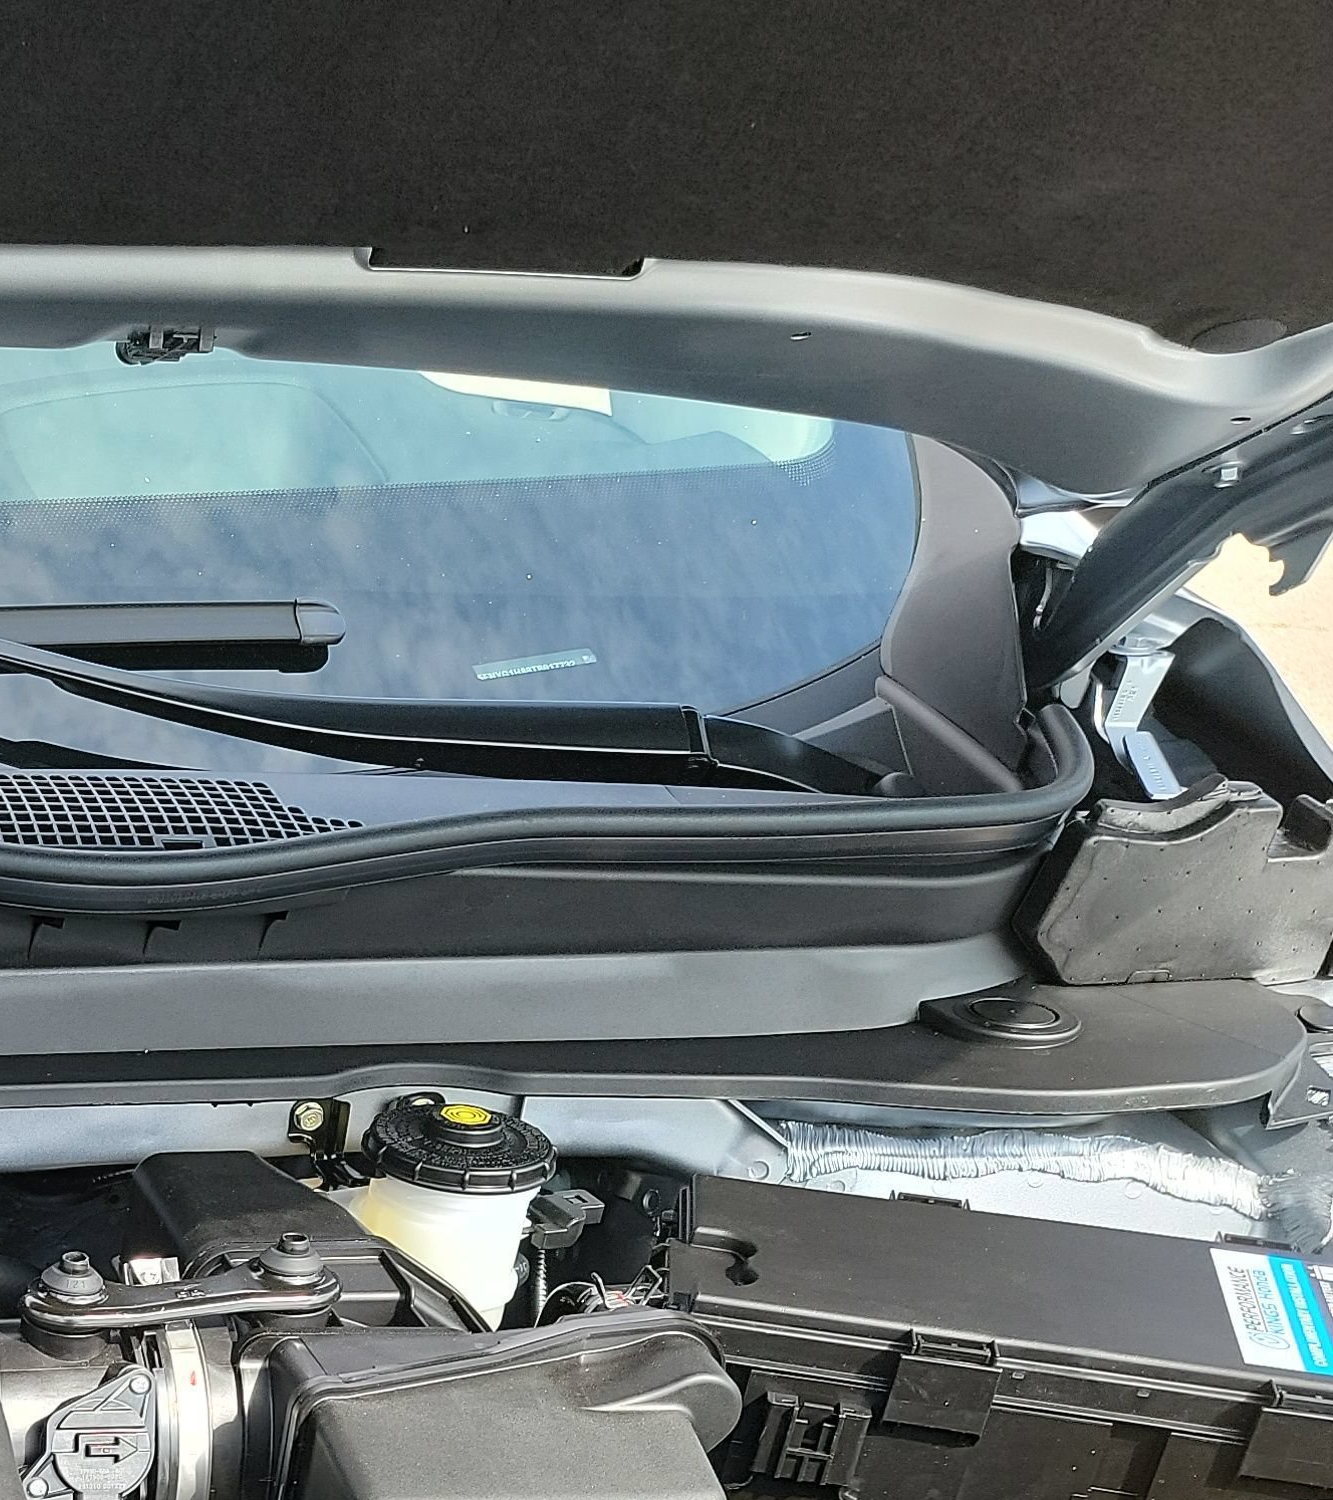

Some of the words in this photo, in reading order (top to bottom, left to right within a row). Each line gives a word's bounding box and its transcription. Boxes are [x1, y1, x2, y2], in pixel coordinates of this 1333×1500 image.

[1226, 1265, 1265, 1333] PERFORMANCE
[1252, 1269, 1273, 1300] Honda
[1261, 1301, 1285, 1335] KINGS
